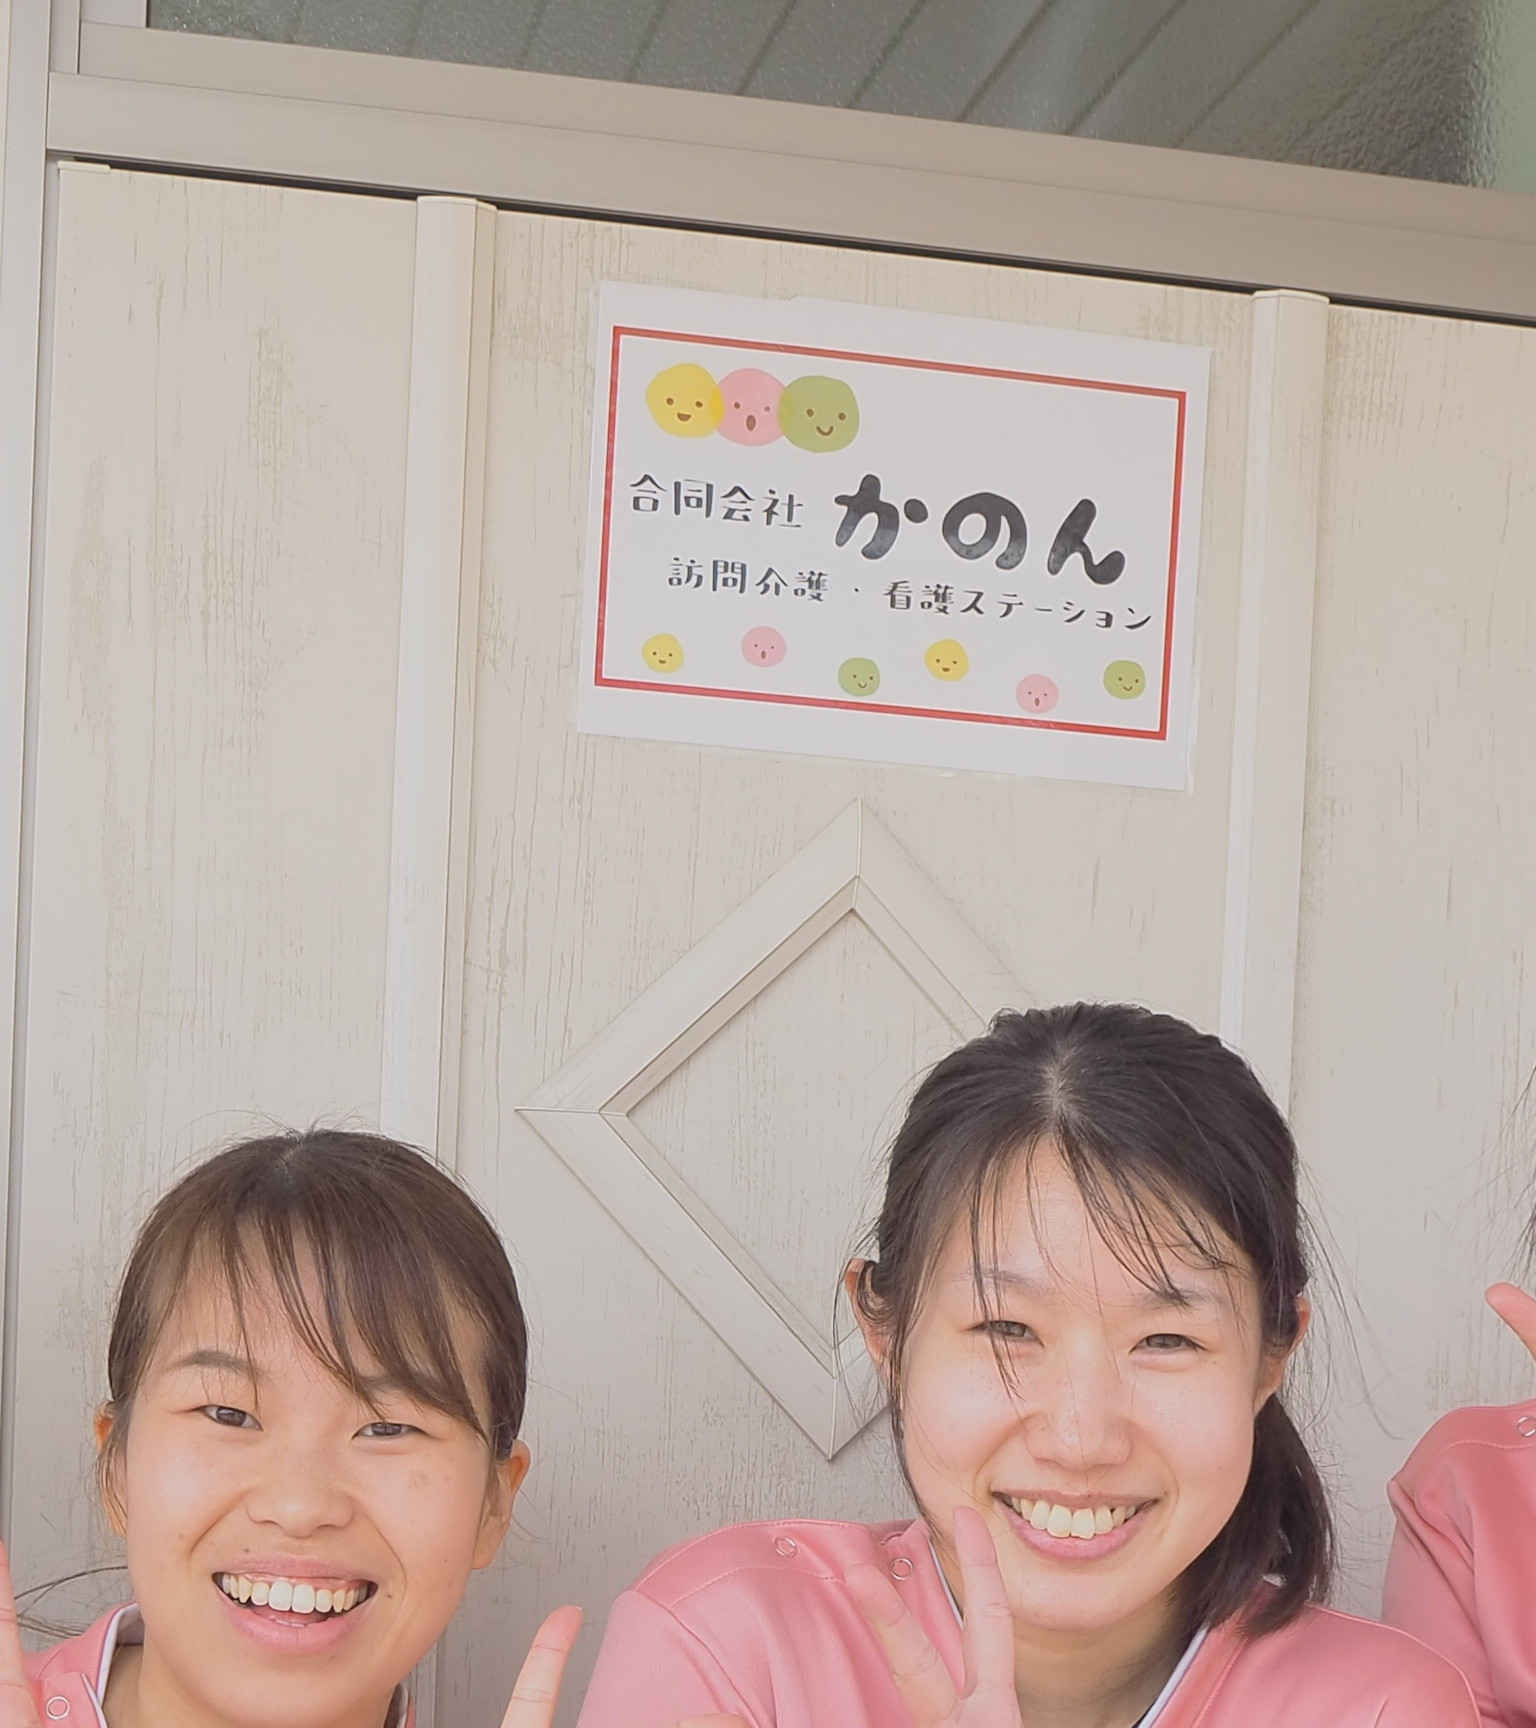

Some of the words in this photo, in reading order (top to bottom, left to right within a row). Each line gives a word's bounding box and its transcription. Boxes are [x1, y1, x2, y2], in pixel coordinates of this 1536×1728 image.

[629, 473, 803, 527] 合同会社
[834, 473, 1126, 585] かのん
